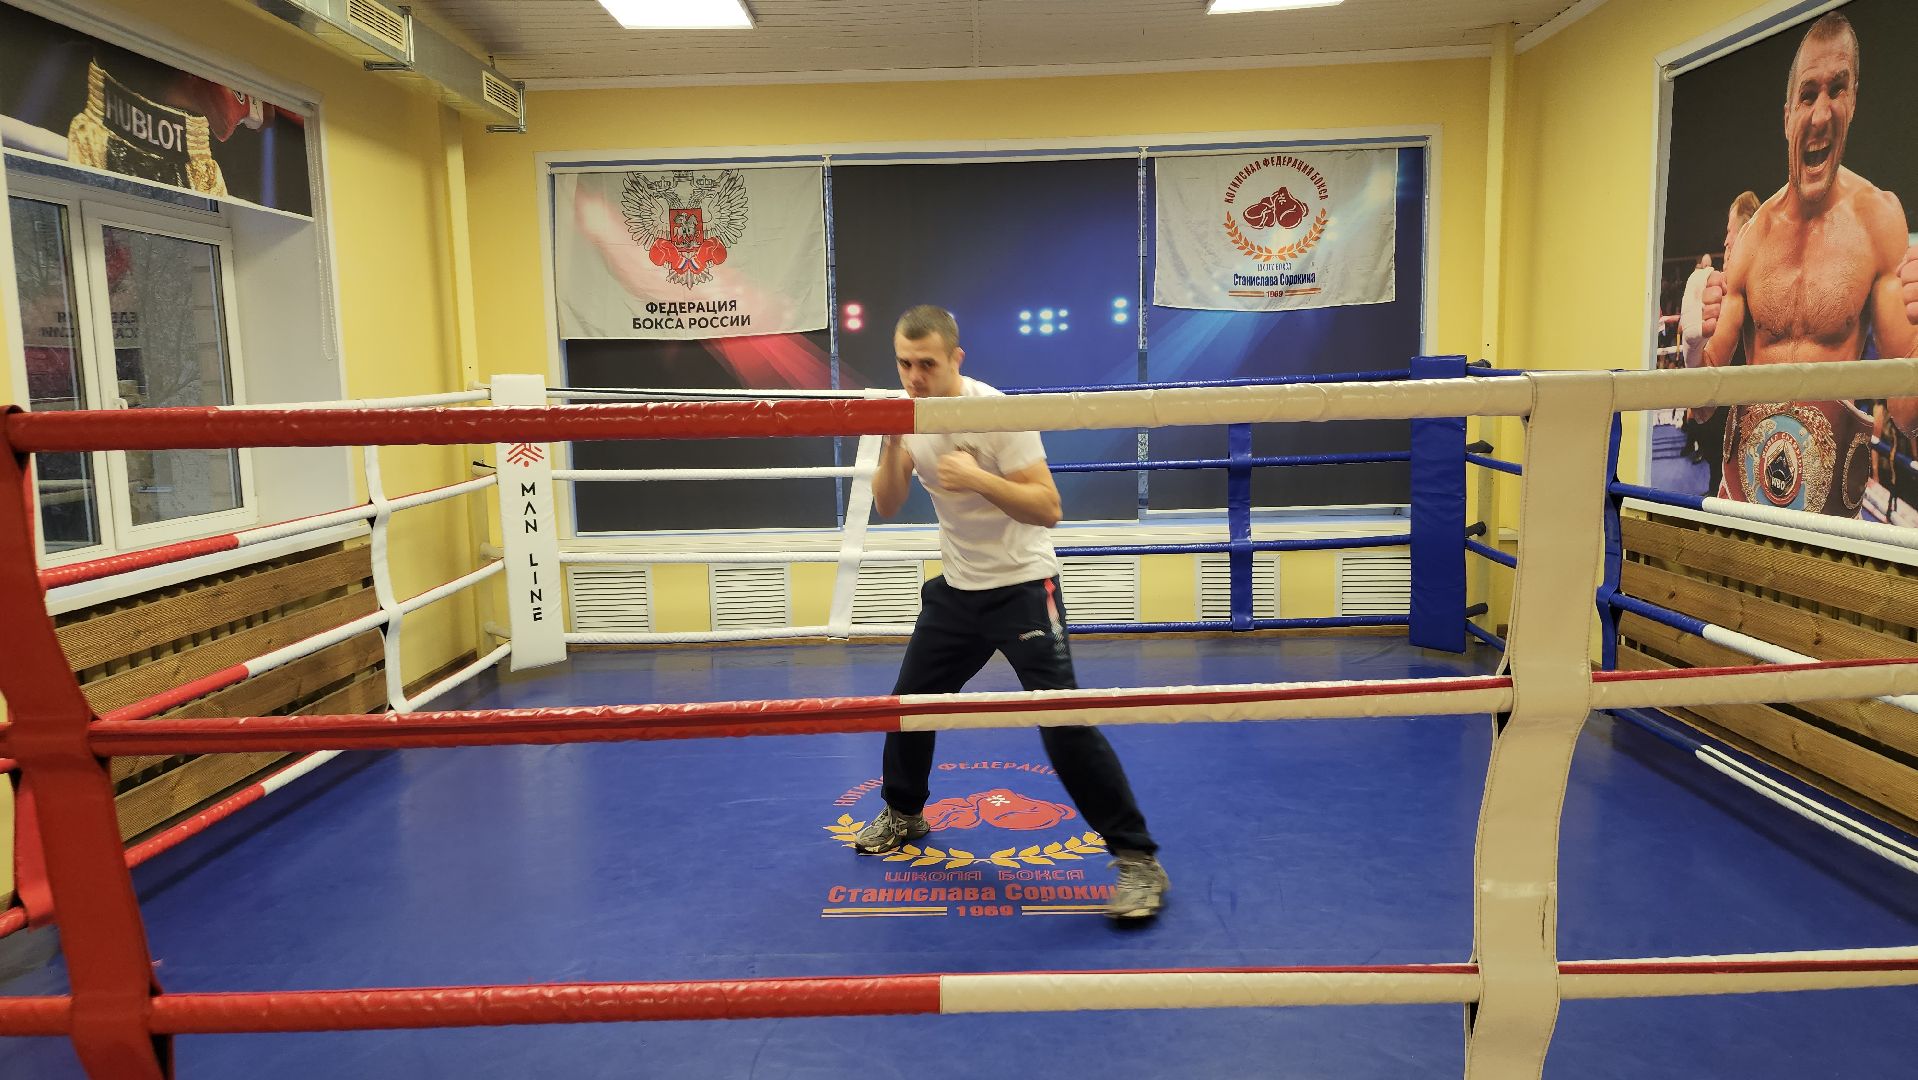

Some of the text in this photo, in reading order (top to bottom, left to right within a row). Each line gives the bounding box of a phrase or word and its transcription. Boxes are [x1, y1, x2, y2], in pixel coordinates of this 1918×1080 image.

[105, 93, 184, 152] HUBLOT
[1262, 155, 1315, 177] ФЕДЕРАЦИЯ
[1310, 172, 1329, 201] БОКСА
[1233, 272, 1316, 288] Станислава Сорокина
[1266, 290, 1284, 298] 1969
[645, 299, 737, 317] ФЕДЕРАЦИЯ
[632, 314, 751, 330] БОКСА РОССИИ
[1771, 476, 1786, 491] WBO
[521, 481, 542, 622] MAN LINE
[937, 761, 1059, 776] ФЕДЕРАЦ
[885, 869, 1085, 882] ШКОЛА БОКСА
[827, 883, 1119, 903] Станислава Сороки
[956, 905, 1014, 917] 1969
